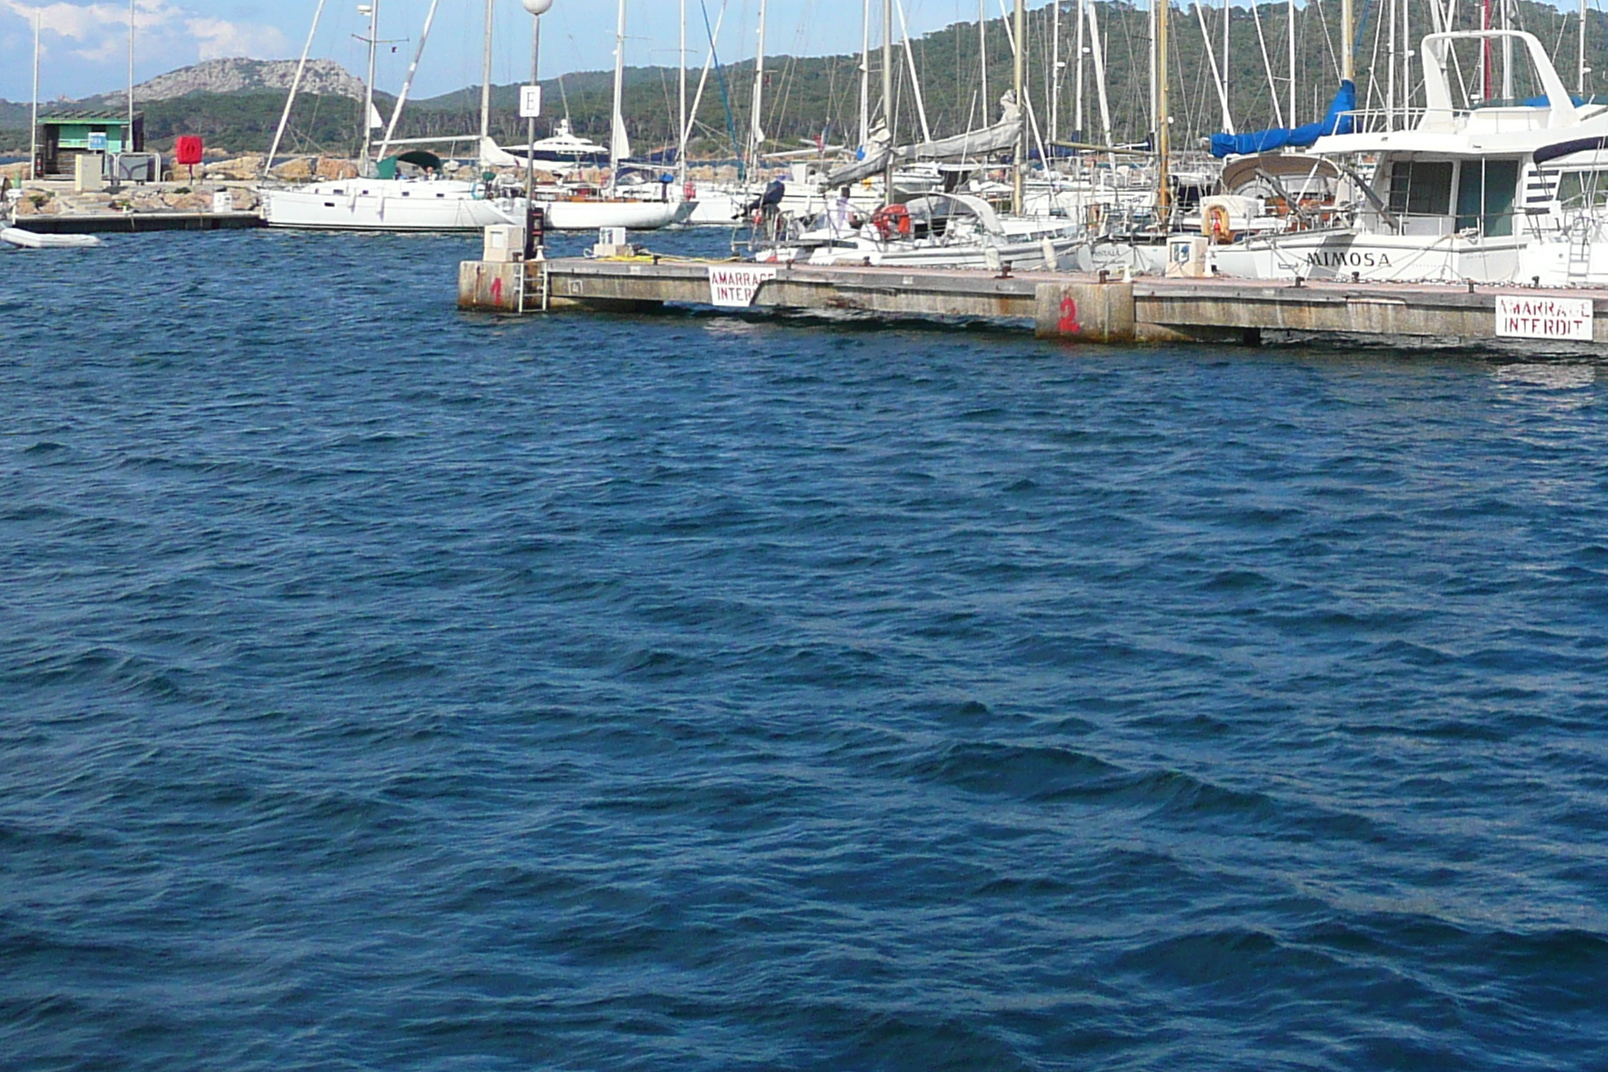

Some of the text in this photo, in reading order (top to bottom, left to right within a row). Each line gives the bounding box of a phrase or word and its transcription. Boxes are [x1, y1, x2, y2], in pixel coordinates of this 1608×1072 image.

[525, 91, 536, 111] E
[1306, 251, 1392, 268] MIMOSA
[717, 287, 756, 301] INTER
[1058, 297, 1080, 334] 2
[1504, 317, 1583, 336] INTERDIT
